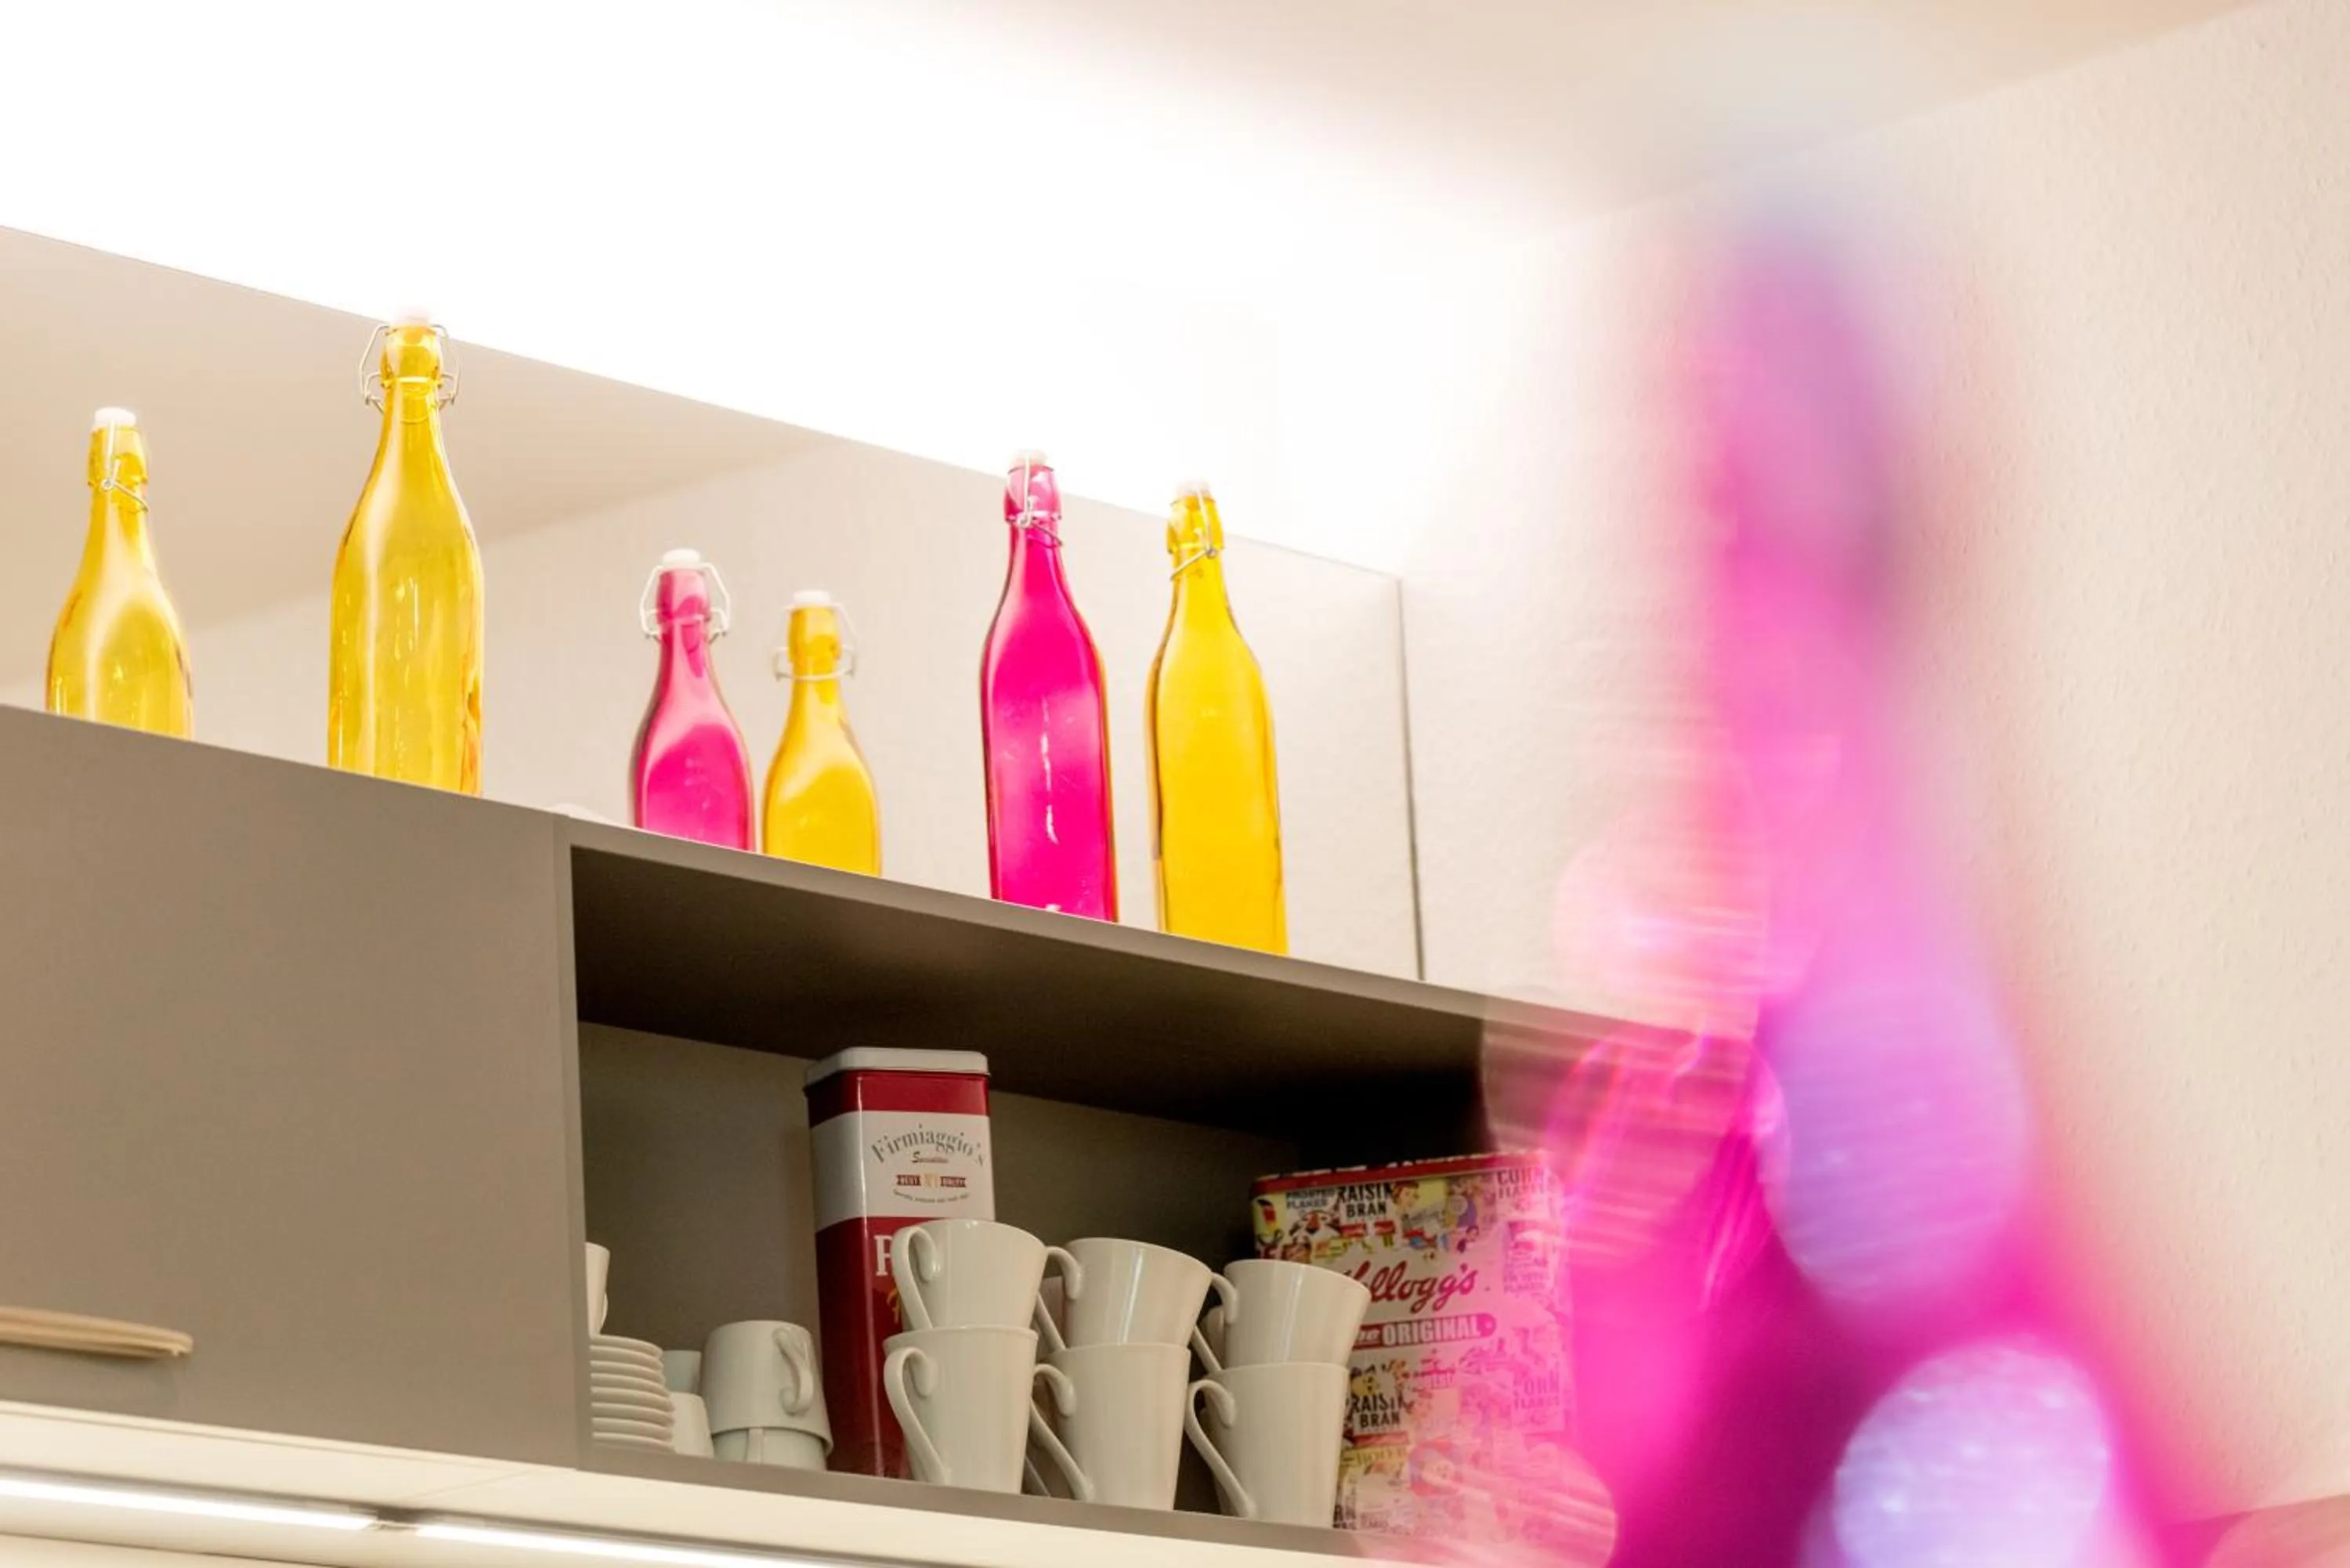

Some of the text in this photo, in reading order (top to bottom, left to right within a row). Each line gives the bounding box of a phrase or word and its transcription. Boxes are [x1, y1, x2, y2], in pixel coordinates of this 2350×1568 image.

[872, 1123, 984, 1166] Firmiaggio's
[1346, 1201, 1386, 1217] BRAN
[1343, 1259, 1479, 1314] llogg's
[1382, 1315, 1481, 1346] ORIGINAL
[1360, 1411, 1401, 1429] BRAN
